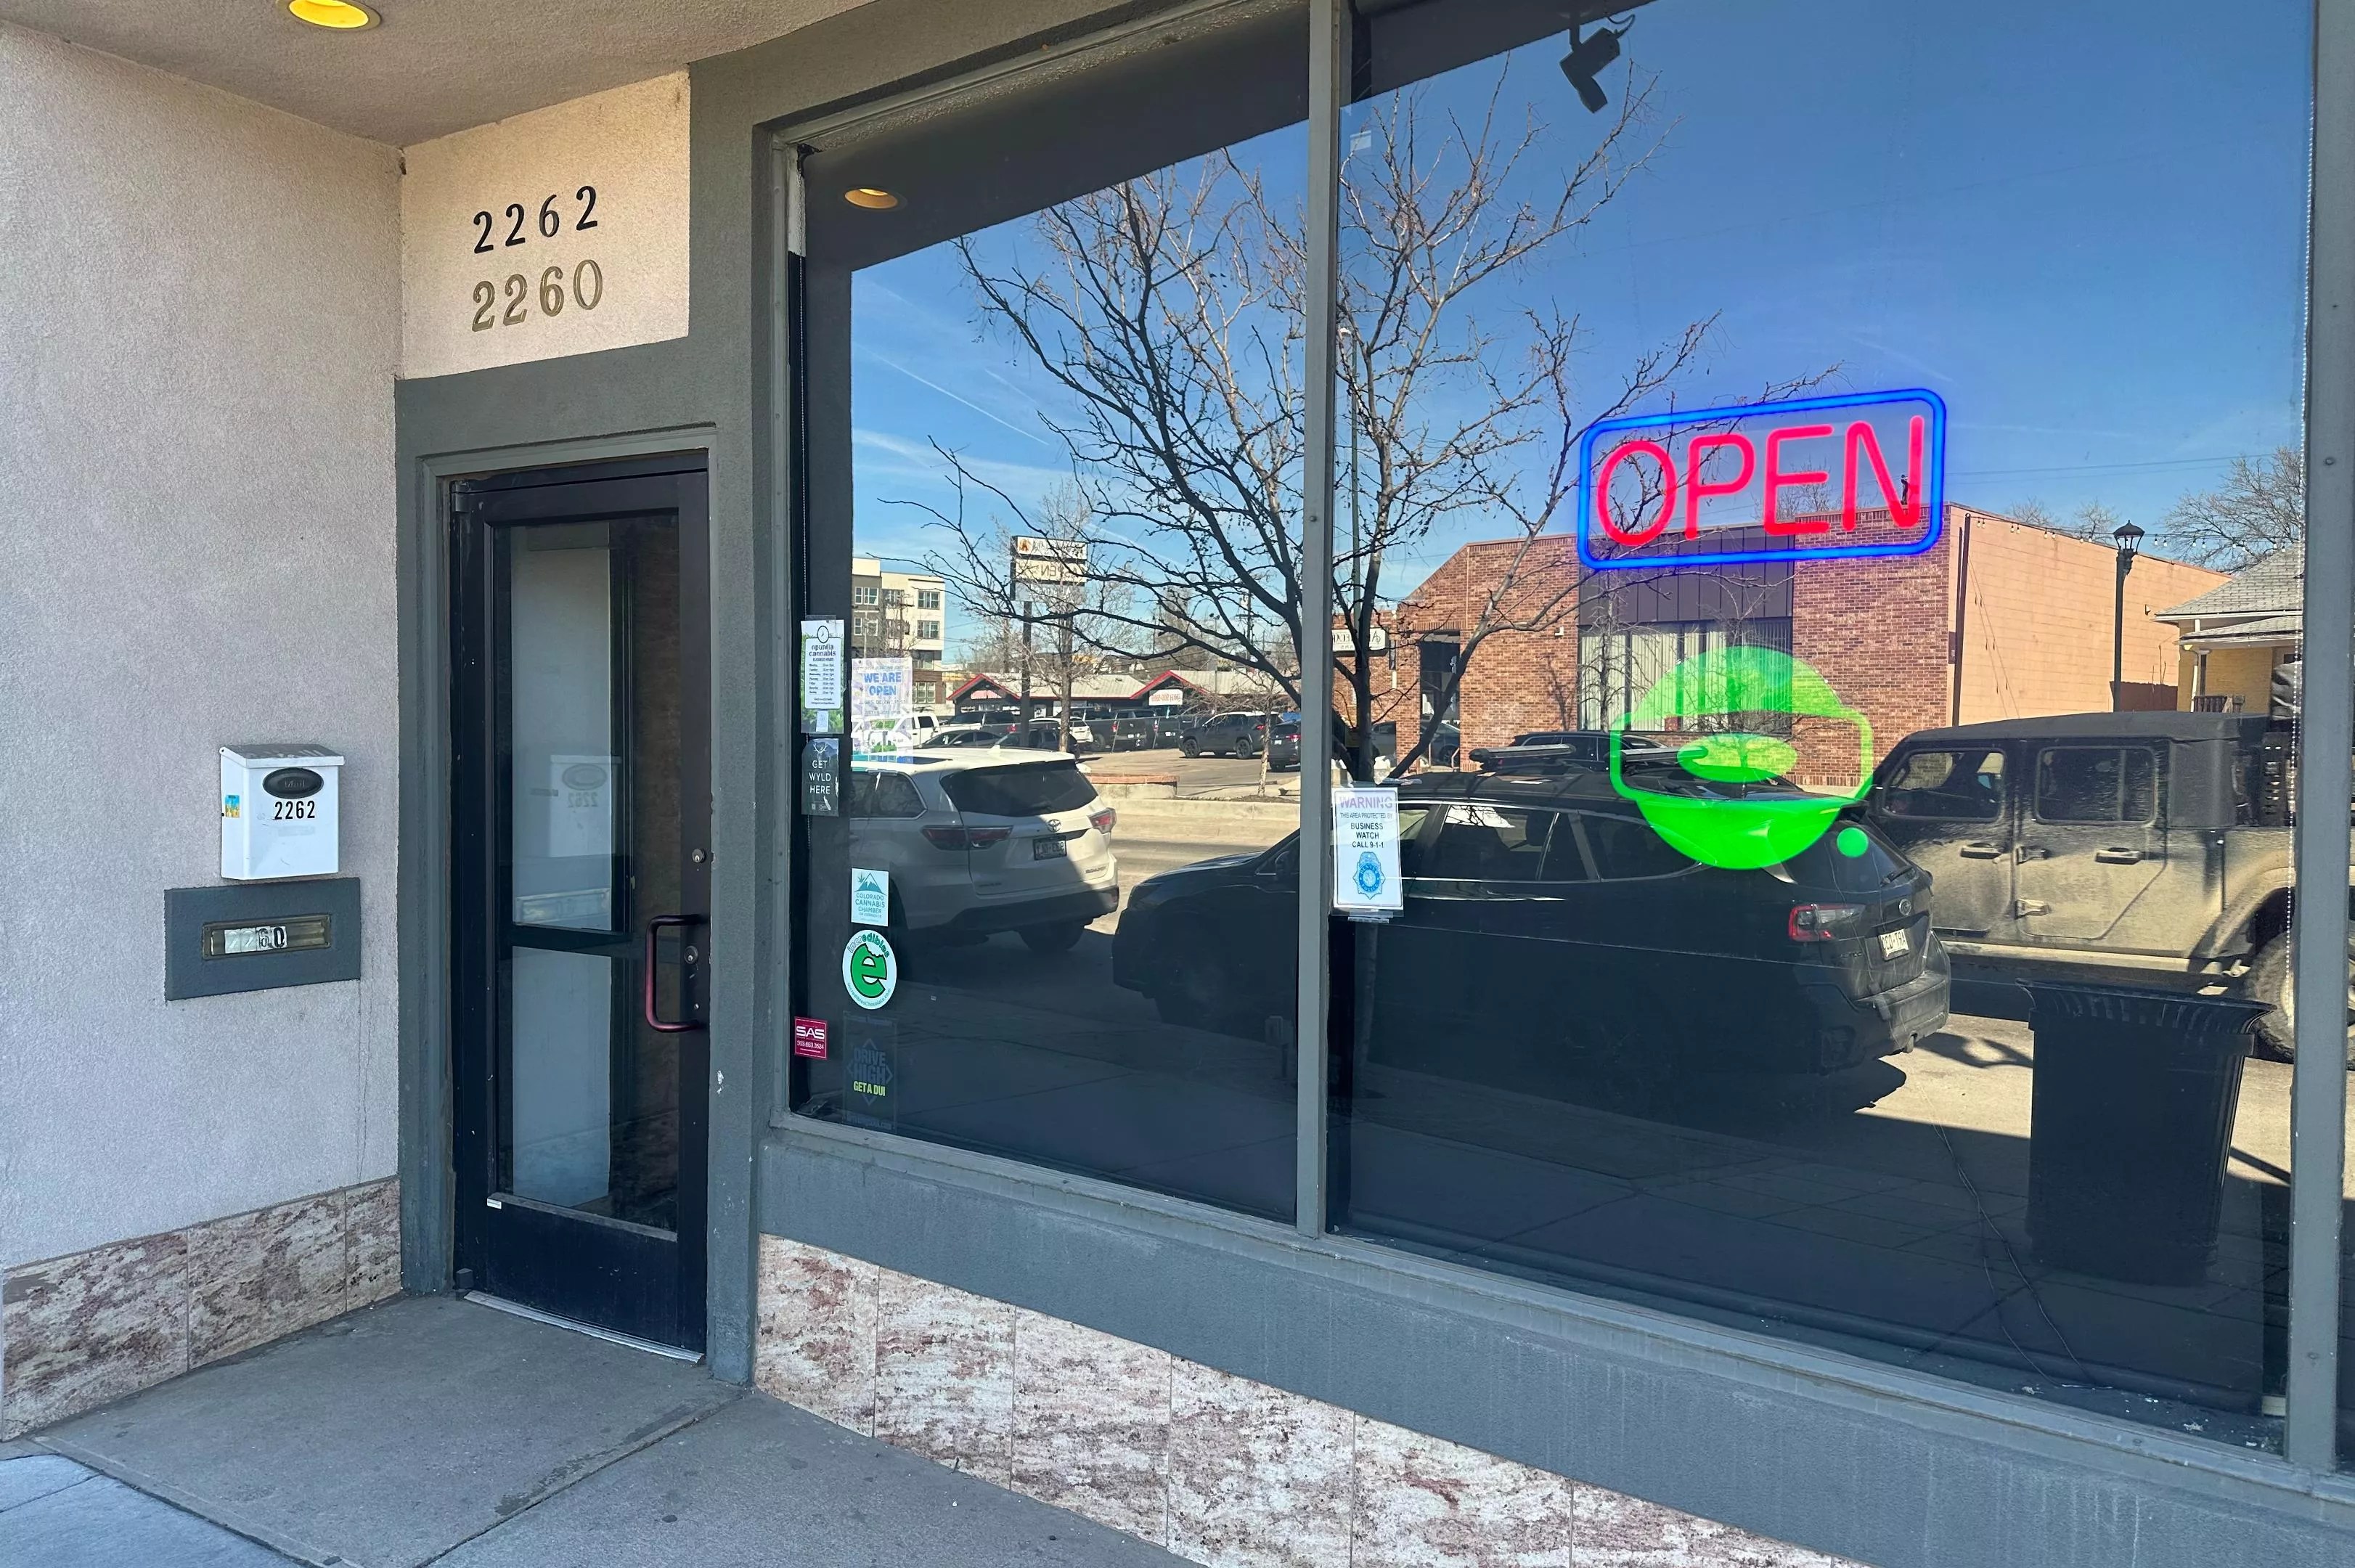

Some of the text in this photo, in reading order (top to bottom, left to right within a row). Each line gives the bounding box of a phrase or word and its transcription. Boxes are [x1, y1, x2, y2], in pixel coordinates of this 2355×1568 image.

[473, 185, 598, 254] 2262
[472, 259, 603, 332] 2260
[1597, 415, 1925, 546] OPEN
[864, 672, 902, 682] WE ARE
[868, 685, 897, 695] OPEN
[812, 760, 828, 769] GET
[808, 772, 831, 782] WYLD
[809, 785, 830, 794] HERE
[1339, 796, 1392, 809] WARNING
[274, 801, 315, 820] 2262
[855, 899, 885, 907] CANNABIS
[847, 933, 890, 957] incredibles
[796, 1026, 825, 1040] SAS
[854, 1048, 886, 1066] DRIVE
[854, 1063, 886, 1085] HIGH
[853, 1081, 886, 1096] GET A DUI
